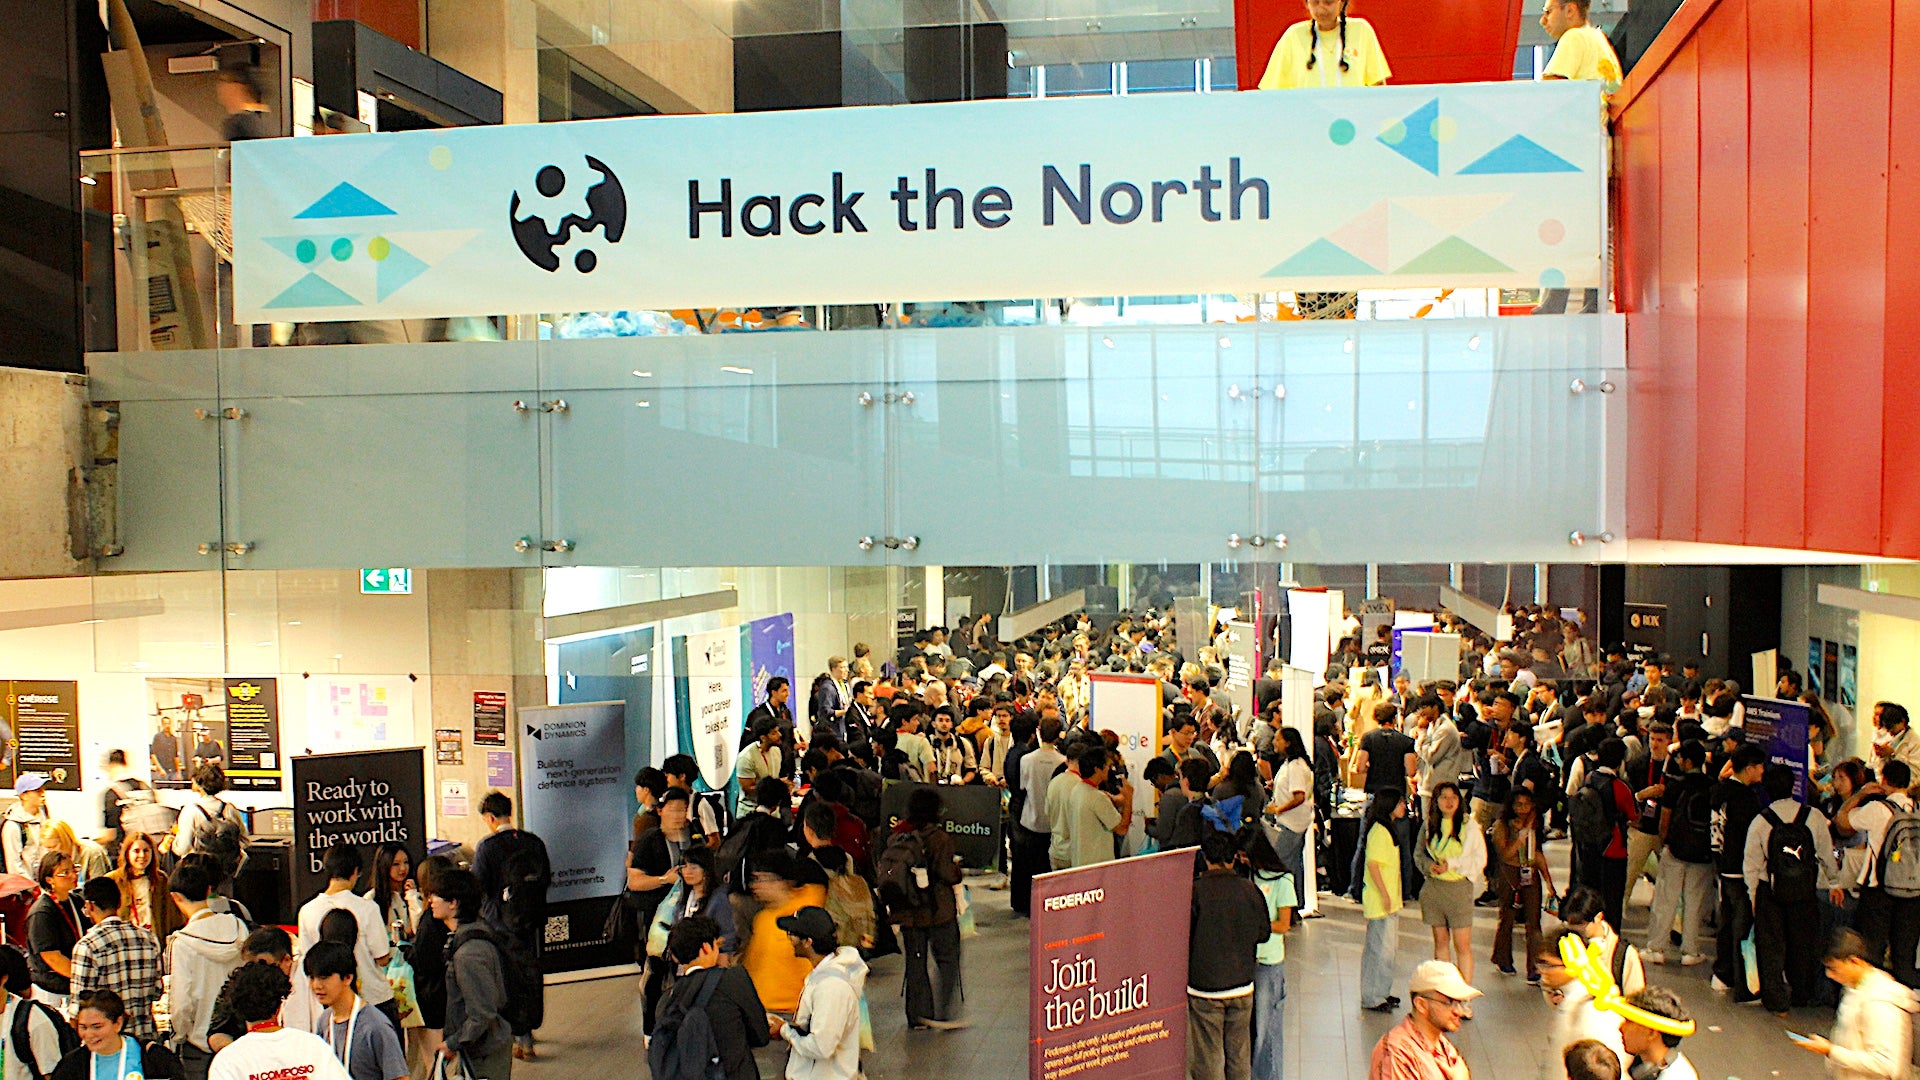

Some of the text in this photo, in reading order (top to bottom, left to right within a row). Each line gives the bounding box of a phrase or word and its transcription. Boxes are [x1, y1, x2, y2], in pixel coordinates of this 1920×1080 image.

[688, 157, 1270, 239] Hack the North
[544, 721, 587, 731] DOMINION
[544, 729, 587, 740] DYNAMICS
[537, 760, 574, 770] Building
[546, 766, 621, 779] next-generation
[306, 777, 390, 805] Ready to
[537, 776, 618, 790] defence systems
[307, 797, 403, 825] work with
[308, 820, 408, 849] the world's
[945, 820, 991, 836] Booths
[558, 866, 596, 878] extreme
[551, 875, 605, 888] nvironments
[1044, 888, 1105, 912] FEDERATO
[1043, 953, 1098, 995] Join
[1044, 973, 1150, 1031] the build
[260, 1064, 314, 1080] COMPOSIO
